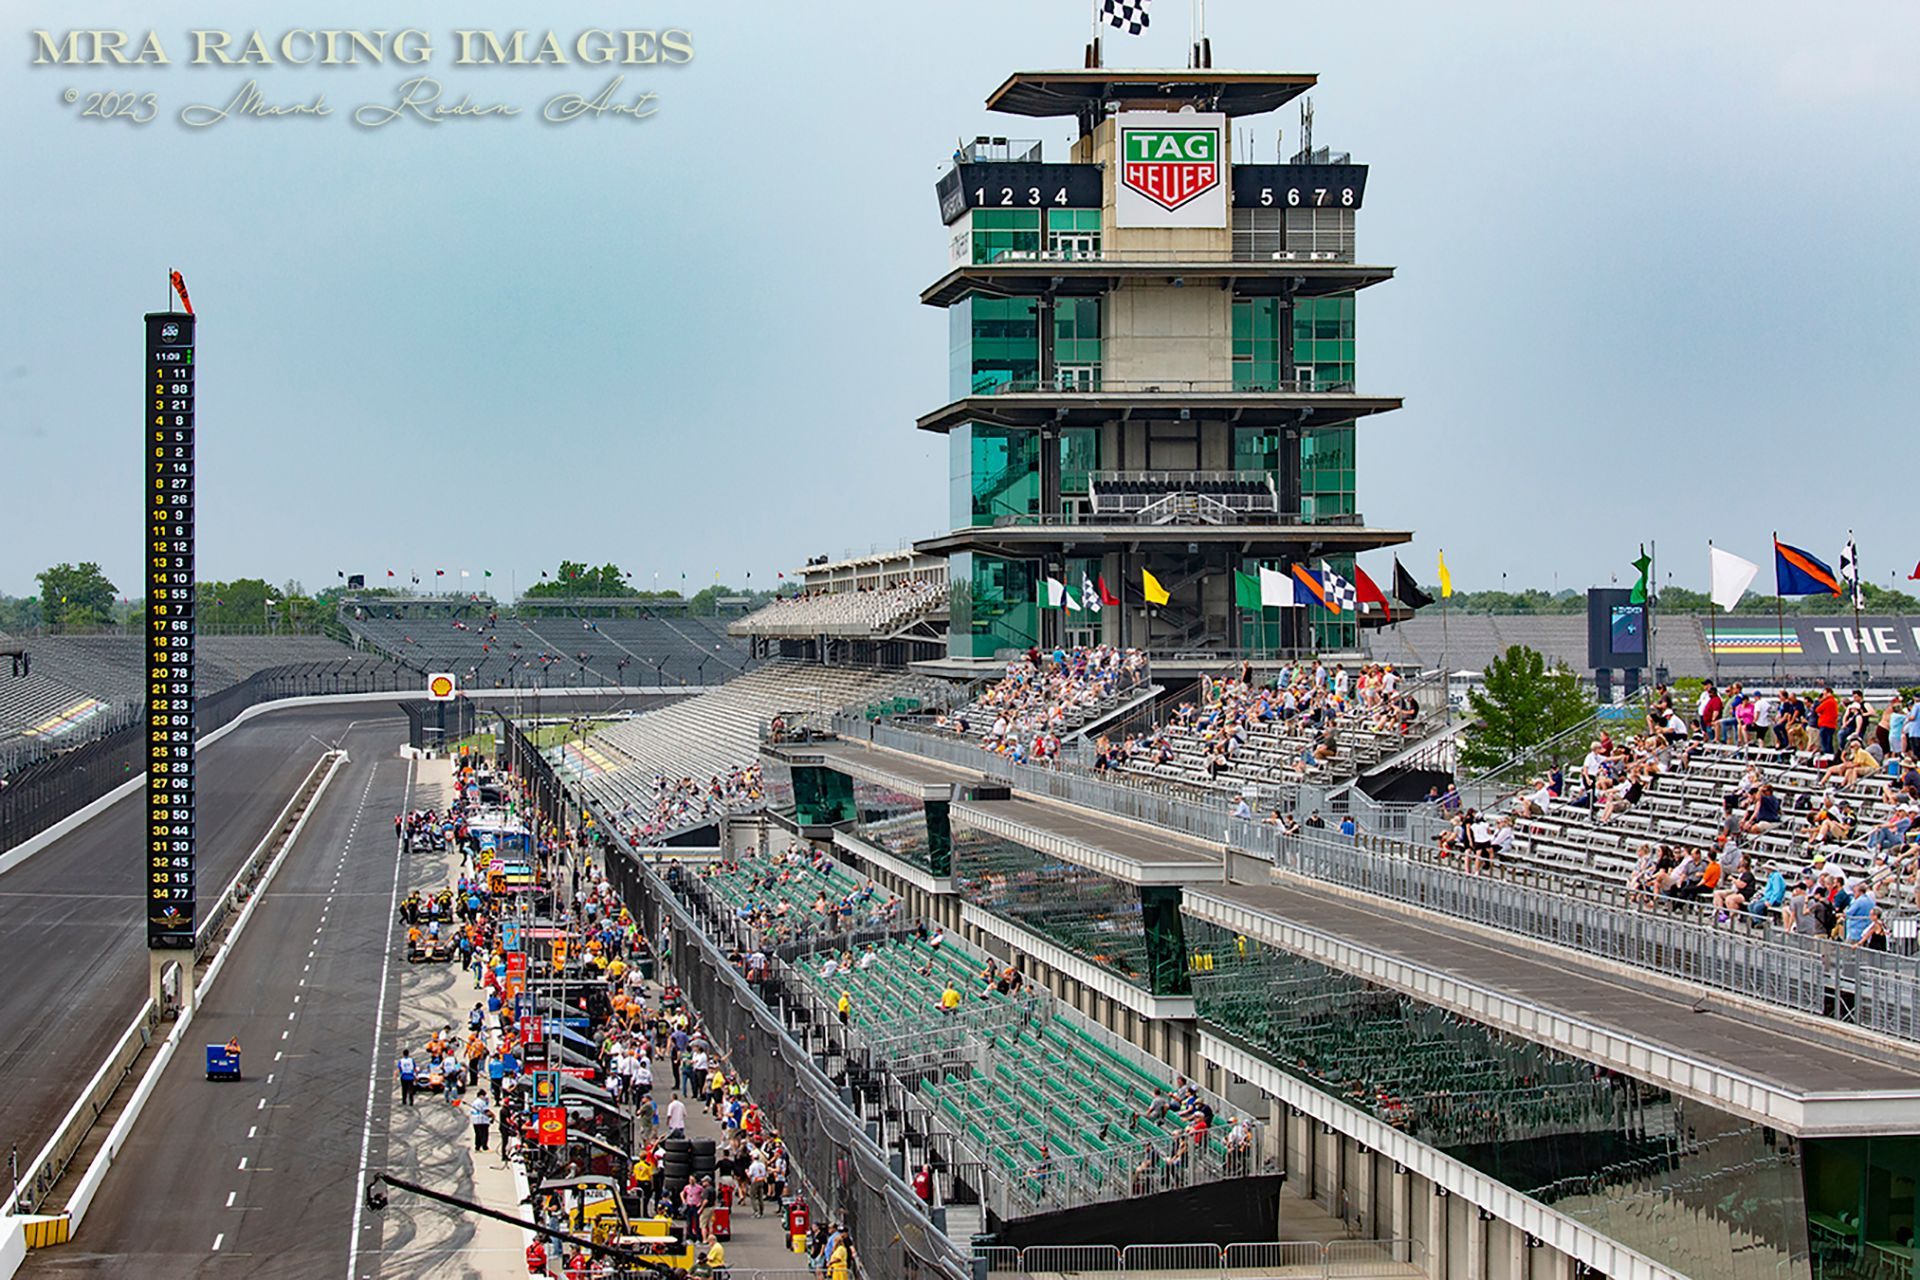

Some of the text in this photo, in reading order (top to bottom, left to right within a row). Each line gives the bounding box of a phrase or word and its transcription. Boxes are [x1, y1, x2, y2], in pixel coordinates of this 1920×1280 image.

[1132, 135, 1208, 158] TAG
[1129, 166, 1212, 202] HEUER
[975, 187, 1068, 205] 1 2 3 4
[1260, 188, 1354, 206] 5 6 7 8
[156, 369, 186, 378] 1 11
[155, 385, 164, 394] 2
[155, 401, 186, 409] 3 21
[155, 416, 184, 425] 4 8
[155, 432, 184, 441] 5 5
[155, 448, 184, 457] 6 2
[155, 464, 187, 472] 7 14
[155, 479, 187, 488] 8 27
[155, 495, 188, 504] 9 26
[153, 510, 183, 520] 10 9
[153, 526, 184, 535] 11 6
[153, 542, 187, 551] 12 12
[153, 558, 184, 567] 13 3
[153, 574, 188, 583] 14 10
[153, 589, 188, 599] 15 55
[153, 605, 183, 614] 16 7
[153, 621, 188, 630] 17 66
[153, 637, 188, 646] 18 20
[1814, 627, 1902, 653] THE
[153, 653, 168, 662] 19
[152, 669, 169, 678] 20
[152, 684, 188, 693] 21 33
[152, 700, 188, 709] 22 23
[152, 716, 189, 725] 23 60
[152, 732, 188, 741] 24 24
[152, 747, 169, 756] 25
[152, 763, 169, 772] 26
[152, 779, 168, 788] 27
[152, 795, 187, 804] 28 51
[152, 810, 189, 819] 29 50
[152, 826, 189, 835] 30 44
[152, 842, 189, 851] 31 30
[152, 858, 189, 867] 32 45
[153, 873, 189, 883] 33 15
[153, 889, 188, 898] 34 77
